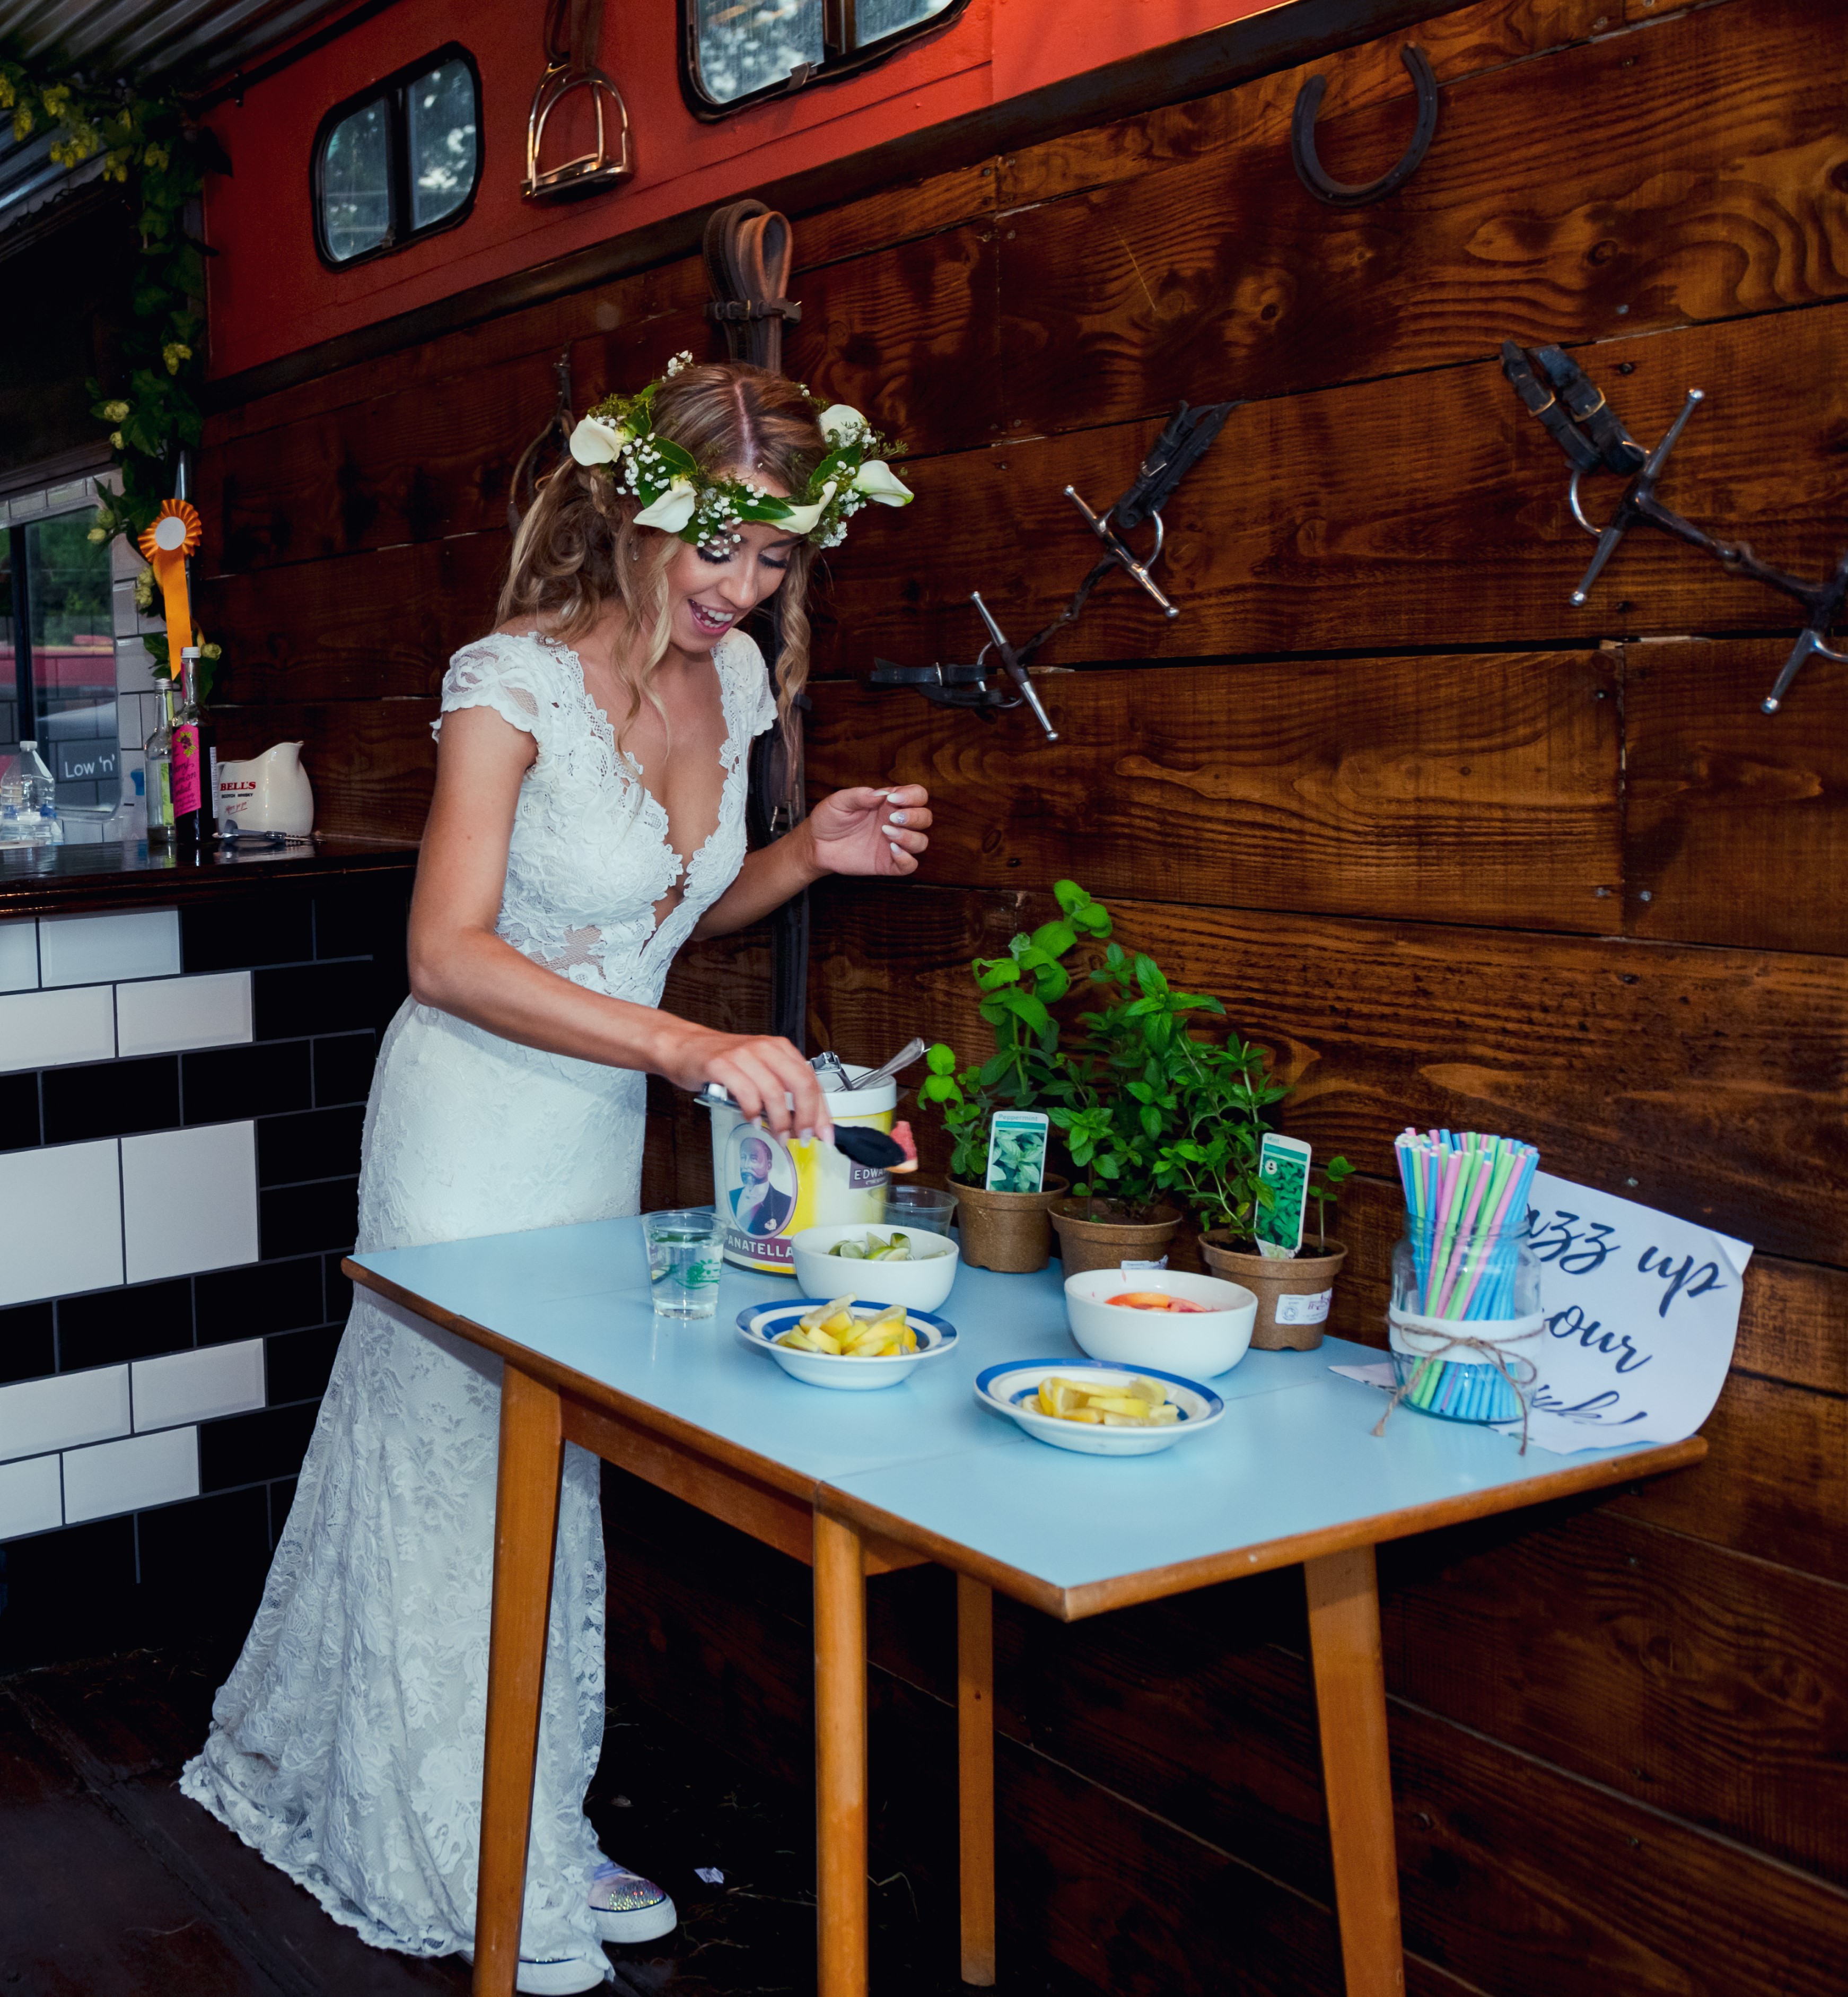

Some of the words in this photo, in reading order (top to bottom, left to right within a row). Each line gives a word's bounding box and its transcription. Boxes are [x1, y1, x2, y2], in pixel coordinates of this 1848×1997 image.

[220, 781, 256, 791] BELL'S
[854, 1168, 885, 1180] EDWA
[724, 1234, 794, 1258] ANATELLA
[1637, 1245, 1728, 1318] up
[1542, 1305, 1653, 1373] our
